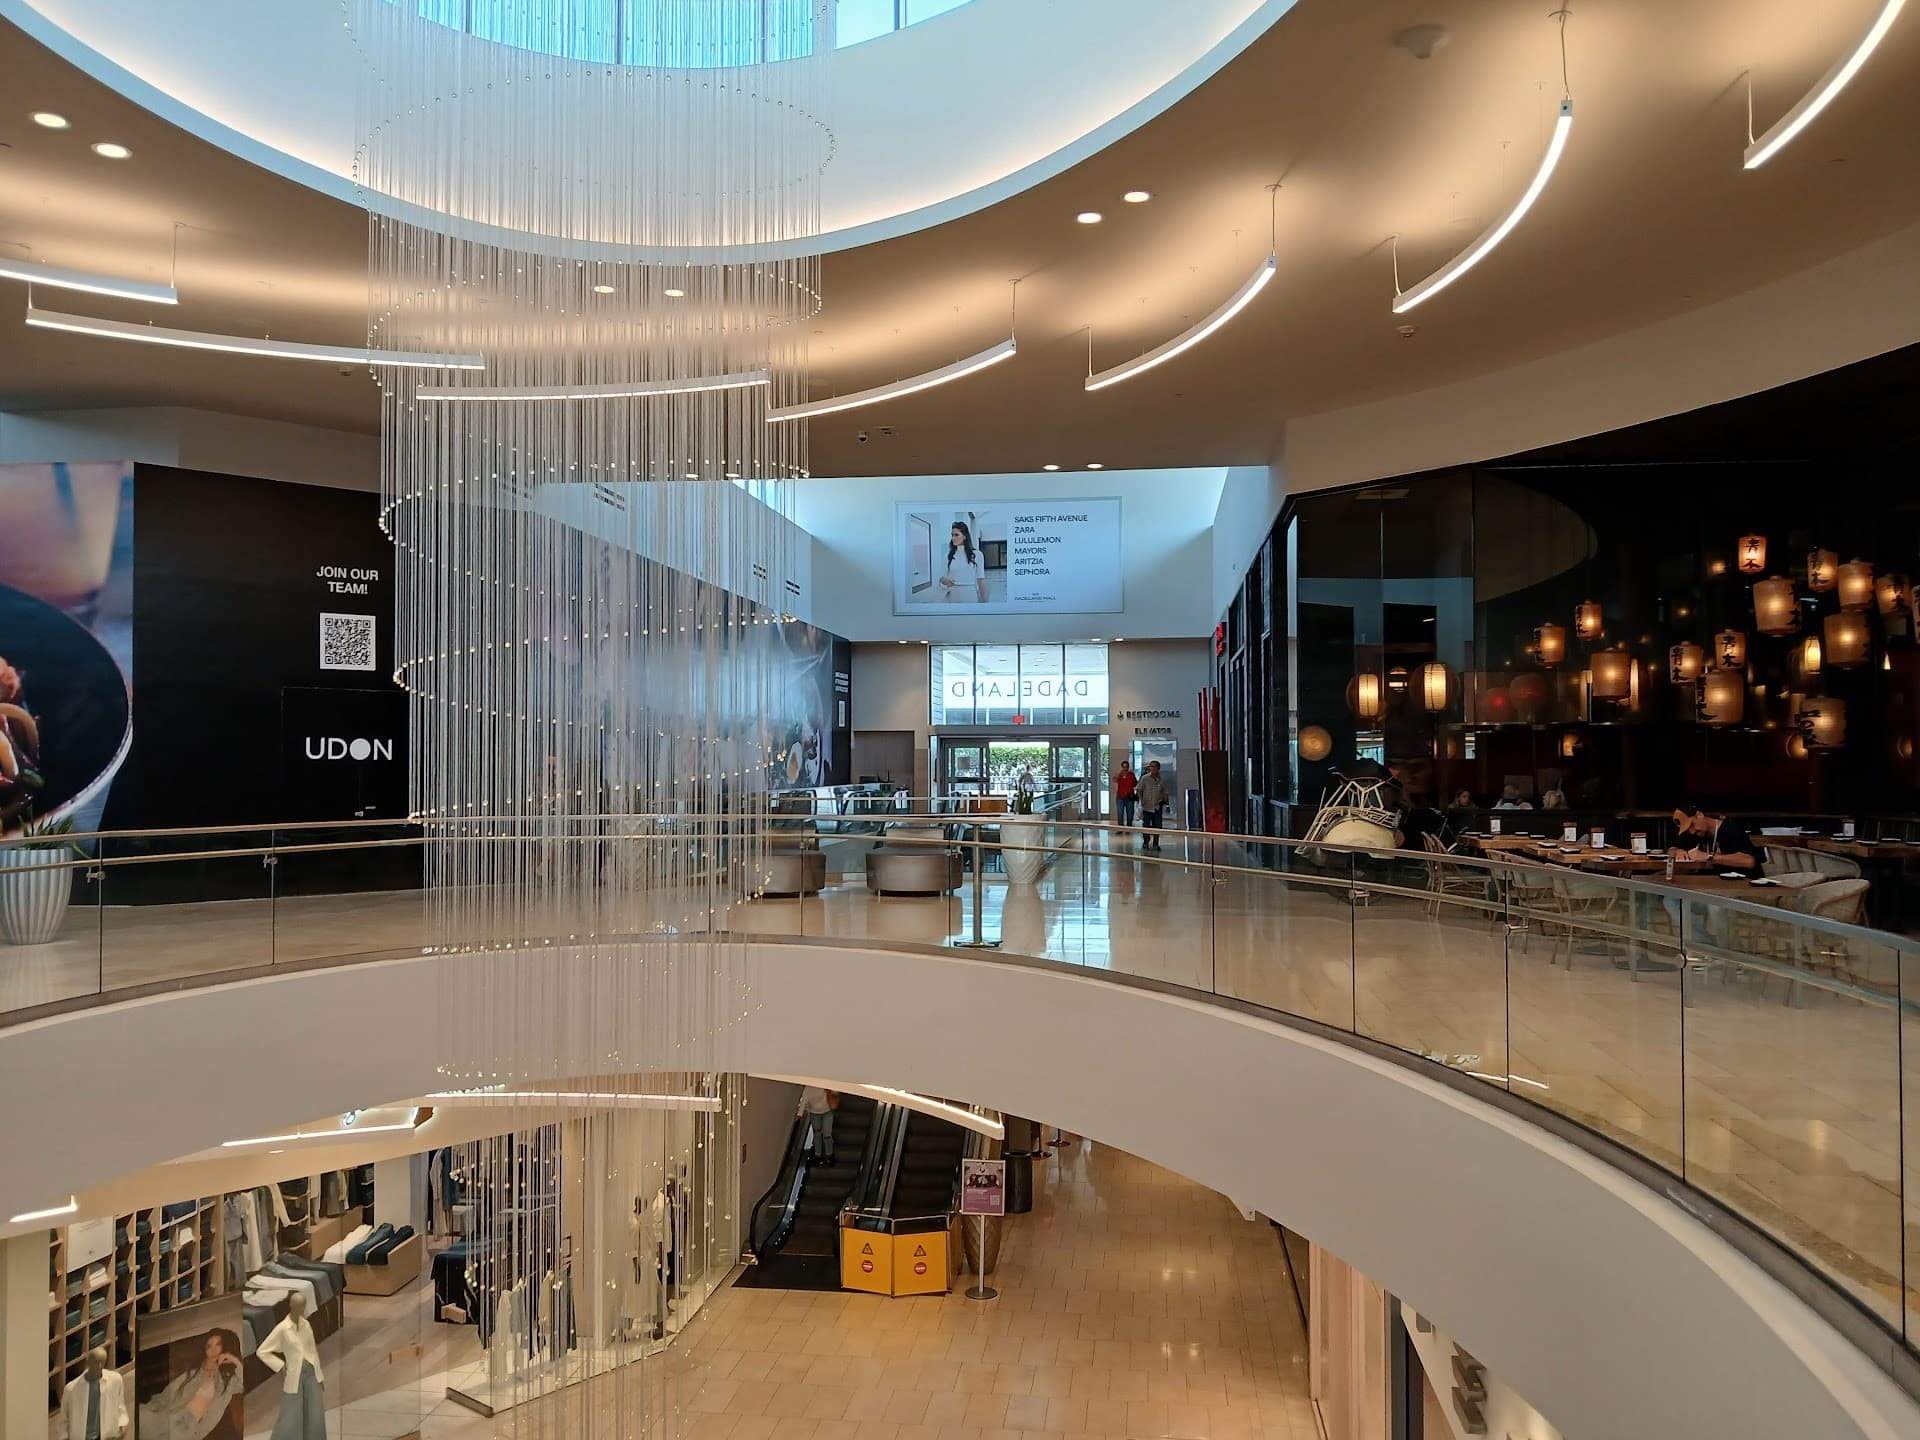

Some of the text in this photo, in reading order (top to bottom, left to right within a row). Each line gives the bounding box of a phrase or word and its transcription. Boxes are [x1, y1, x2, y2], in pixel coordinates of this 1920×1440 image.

[1035, 515, 1057, 523] FIFTH
[1057, 514, 1088, 522] AVENUE
[1014, 526, 1035, 534] ZARA
[1014, 536, 1061, 544] LULULEMON
[1014, 557, 1044, 565] ARITZIA
[316, 566, 379, 581] JOIN OUR
[1014, 568, 1050, 576] SEPHORA
[327, 581, 368, 595] TEAM!
[1134, 727, 1172, 735] ELEVATOR
[305, 737, 393, 760] UDON
